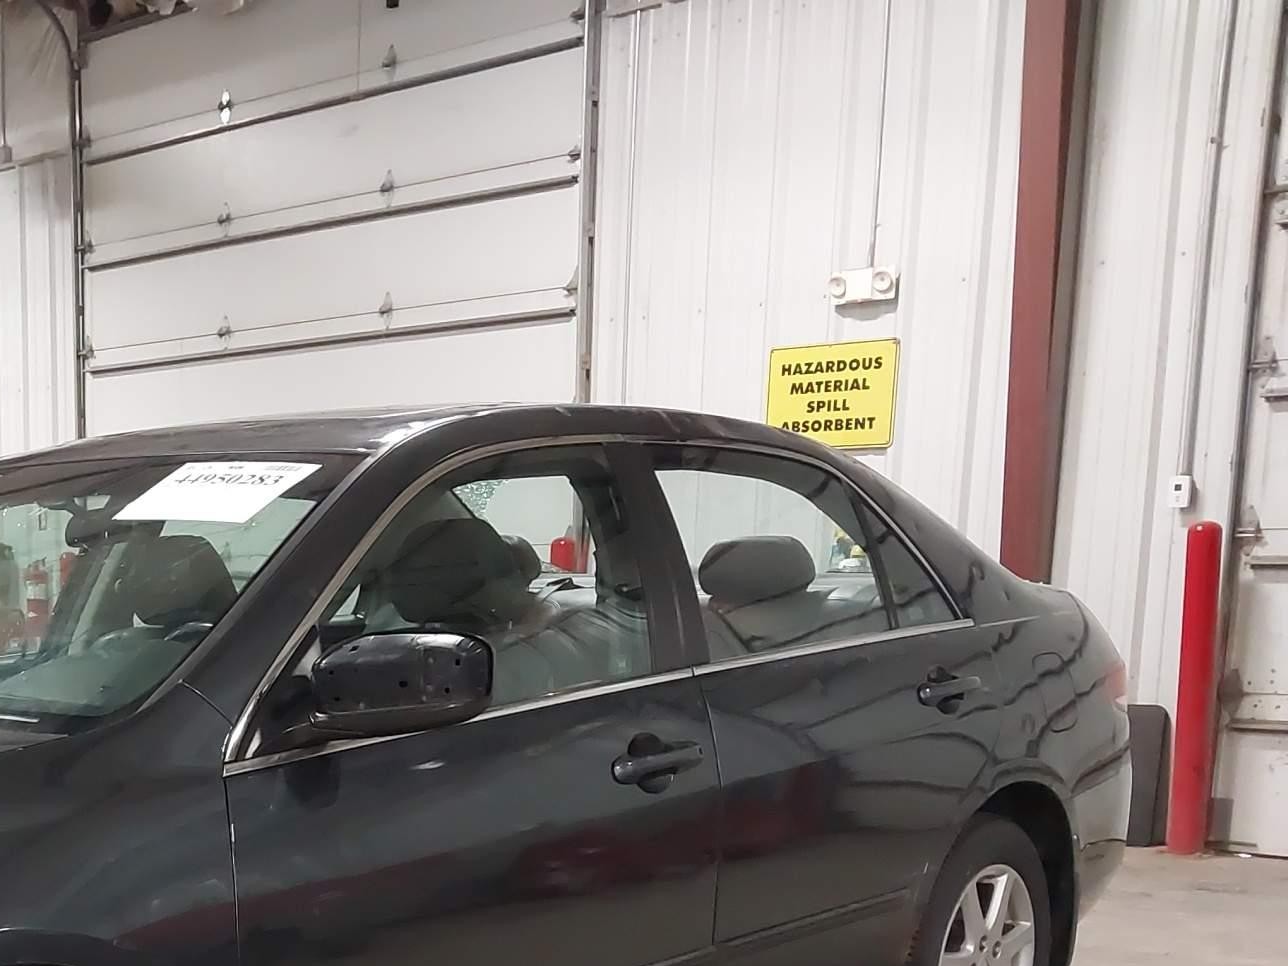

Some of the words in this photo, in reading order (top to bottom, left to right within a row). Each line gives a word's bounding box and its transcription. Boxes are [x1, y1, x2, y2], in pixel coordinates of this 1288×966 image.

[781, 356, 883, 376] HAZARDOUS
[790, 377, 871, 395] MATERIAL
[806, 399, 850, 413] SPILL
[782, 417, 876, 433] ABSORBENT
[174, 473, 285, 486] 44950283
